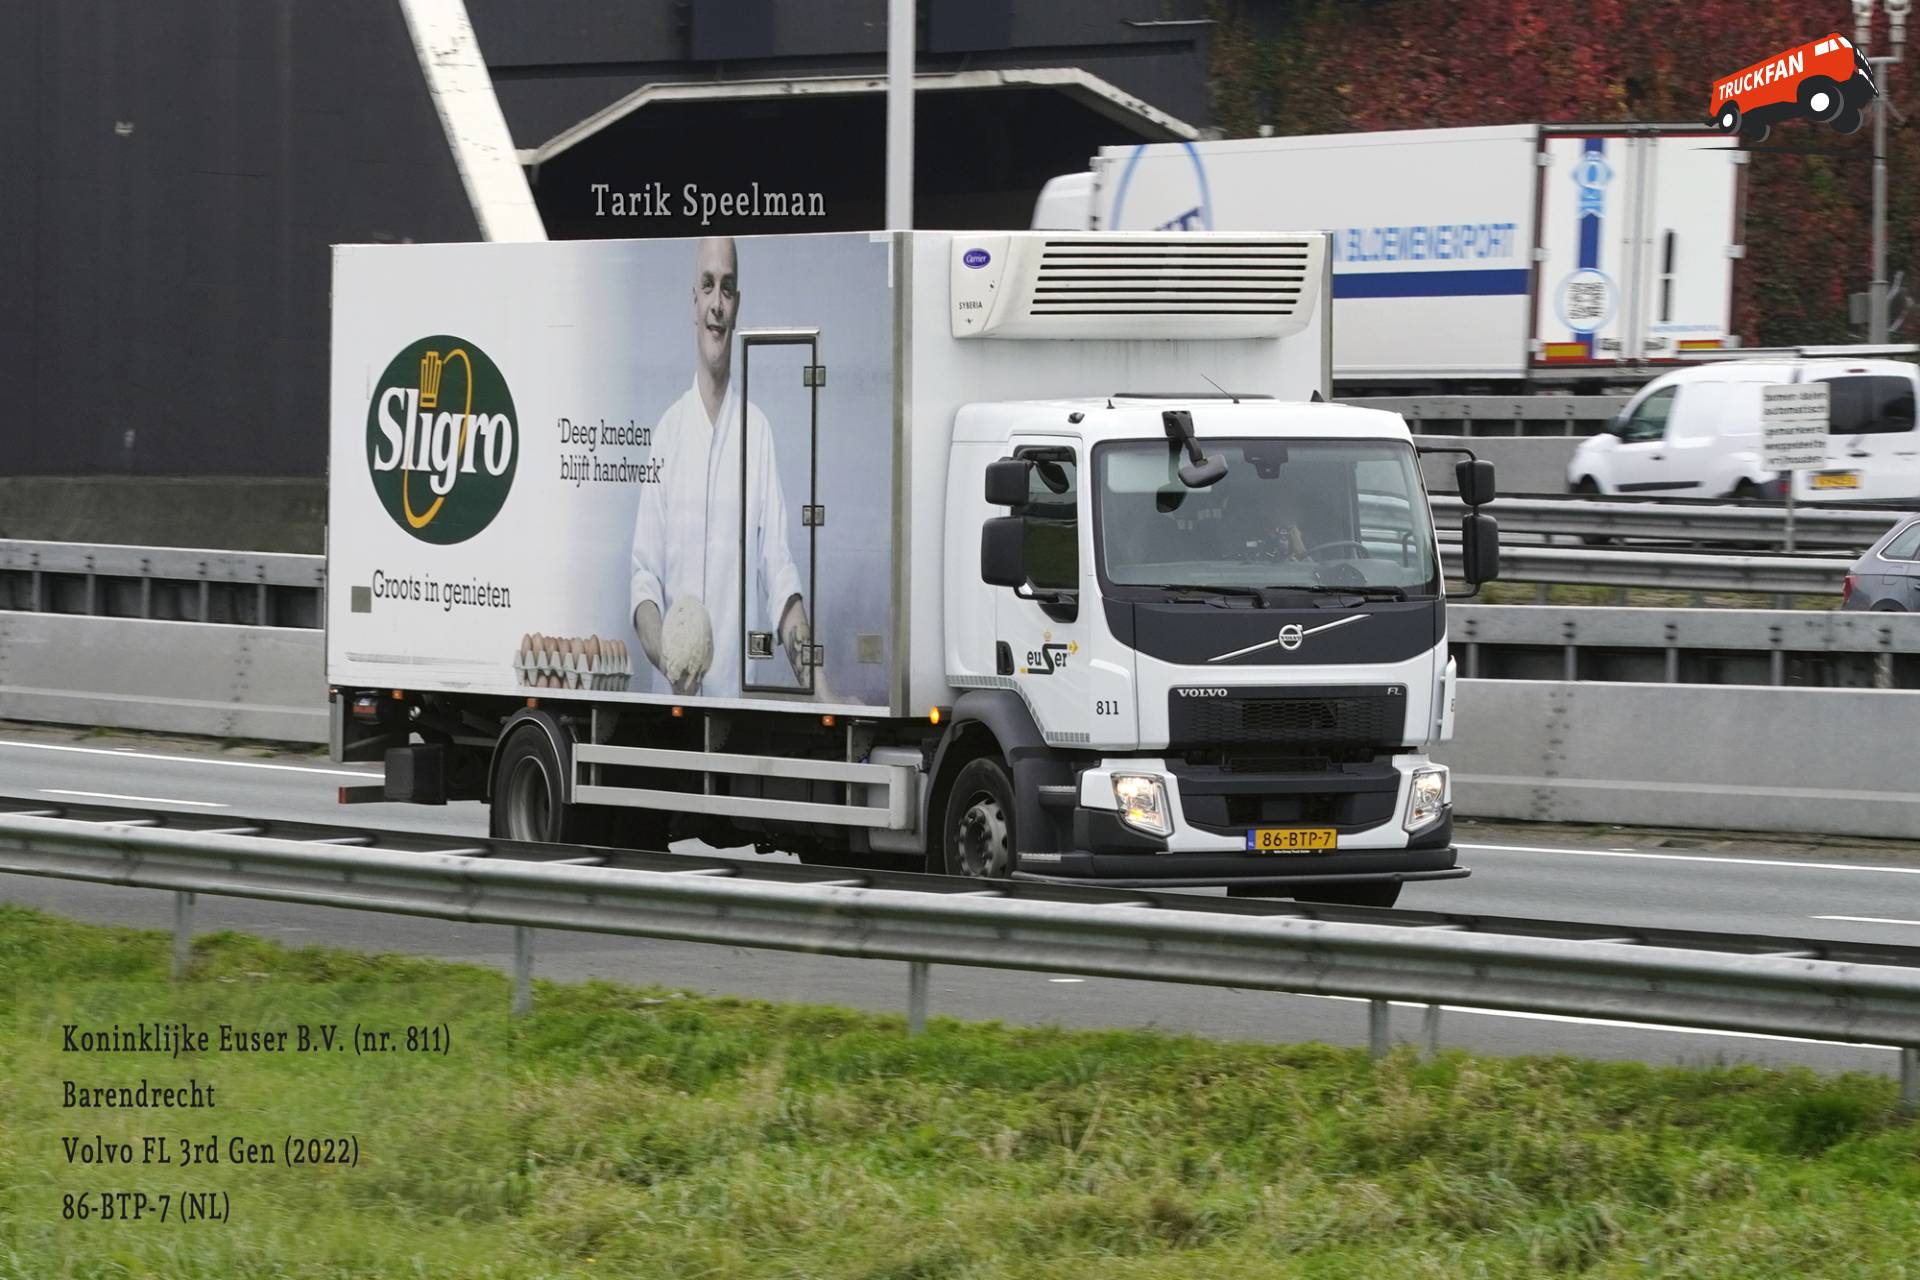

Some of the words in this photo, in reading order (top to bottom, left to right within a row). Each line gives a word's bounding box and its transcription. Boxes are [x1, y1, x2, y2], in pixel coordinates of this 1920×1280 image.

[959, 301, 983, 310] SYBERIA
[600, 418, 652, 446] kneden
[373, 386, 513, 496] Sligro
[560, 454, 590, 488] blijft
[372, 568, 421, 601] Groots
[424, 572, 440, 603] in
[443, 576, 512, 612] genieten
[1177, 688, 1228, 698] VOLVO
[1387, 687, 1402, 696] FL
[1095, 700, 1119, 715] 811
[1262, 831, 1332, 847] 86-BTP-7
